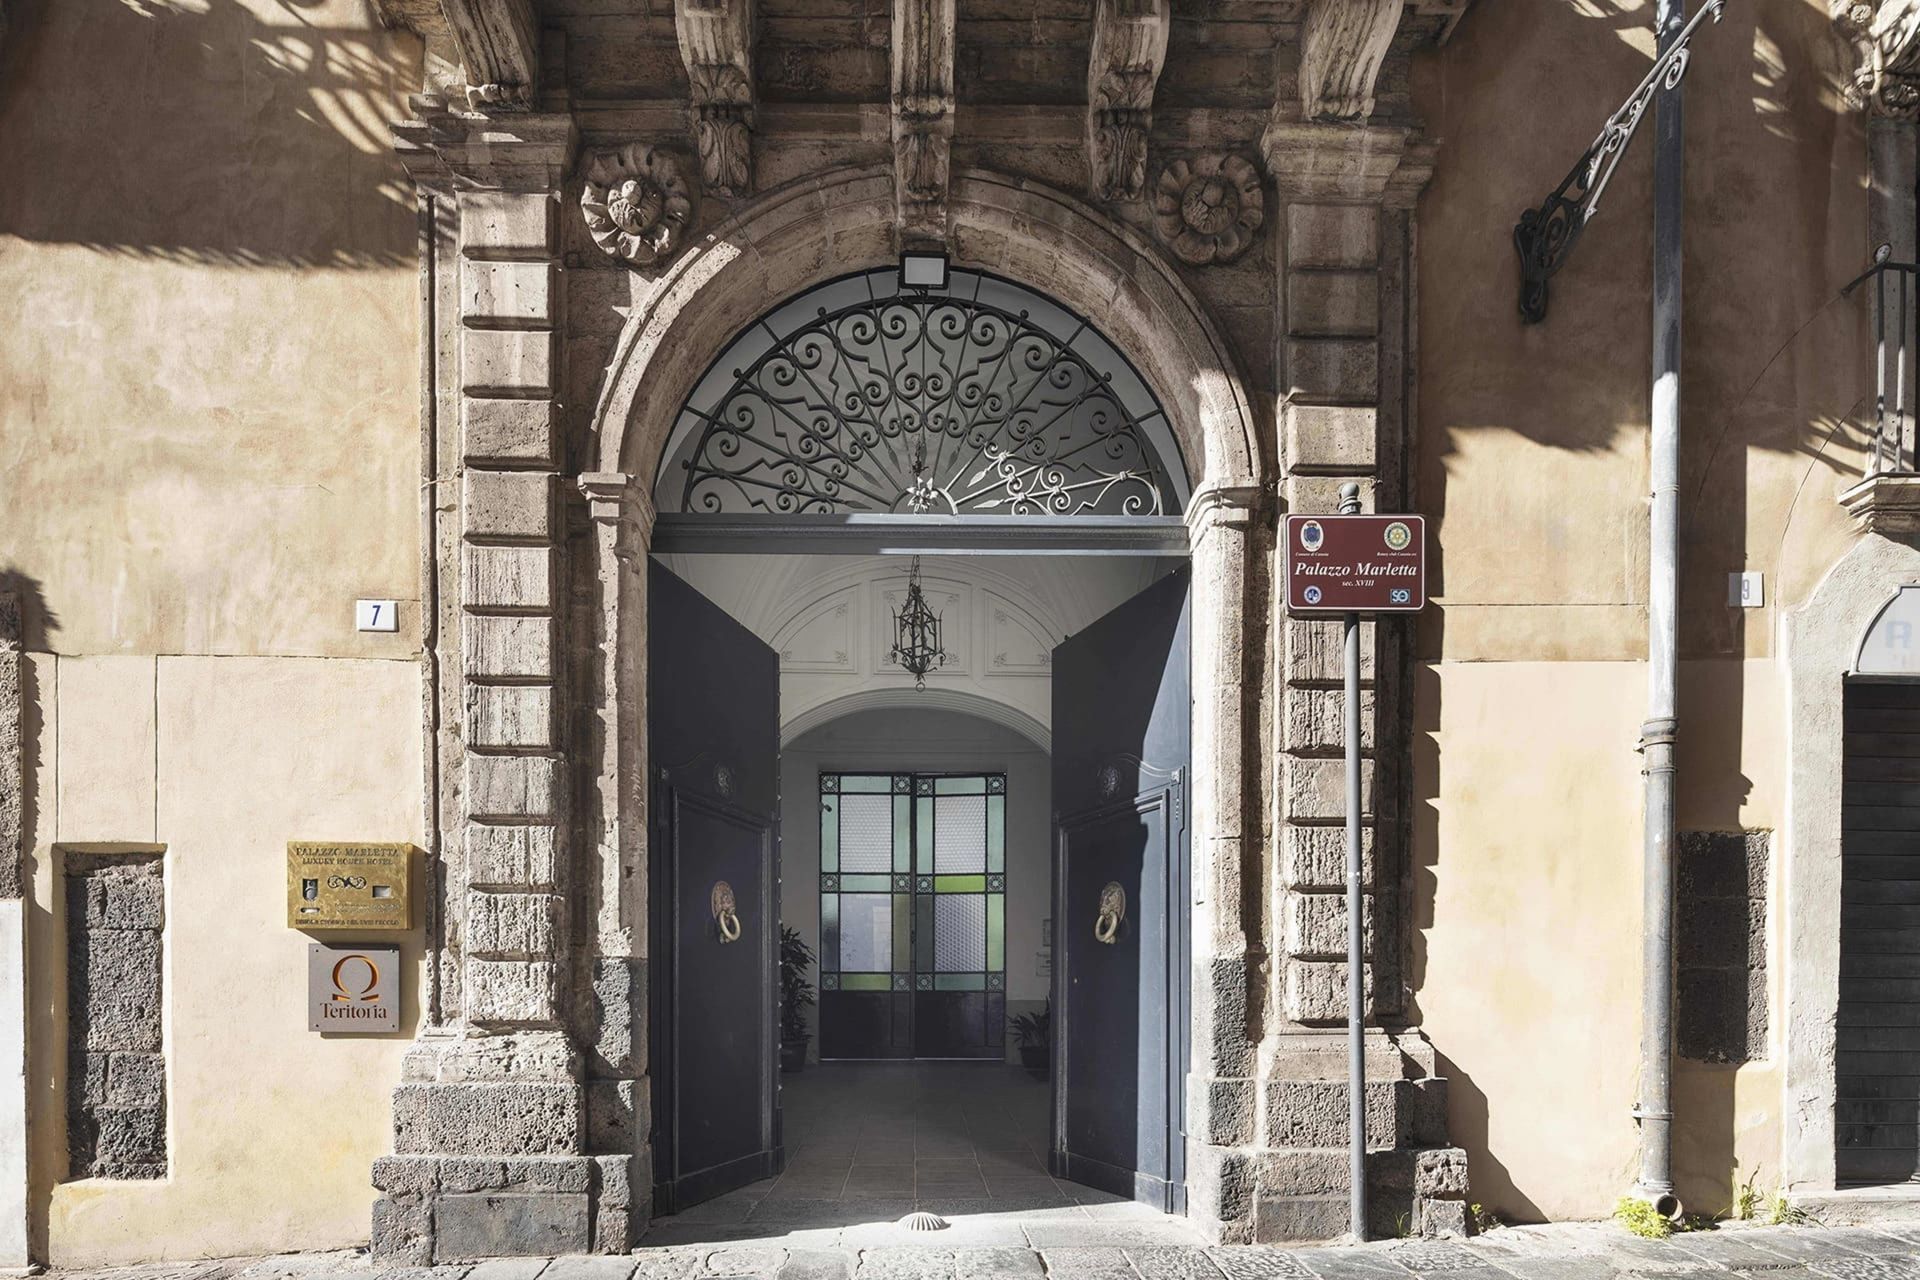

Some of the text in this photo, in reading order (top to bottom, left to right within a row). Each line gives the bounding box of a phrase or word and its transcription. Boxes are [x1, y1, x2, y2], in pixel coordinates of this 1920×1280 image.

[1294, 562, 1417, 577] Palazzo Marletta
[1742, 579, 1750, 600] 9
[372, 605, 381, 626] 7
[296, 847, 399, 857] PALAZZO MARLETTA
[302, 857, 334, 865] LUXURY
[320, 1003, 387, 1019] Teritoria
